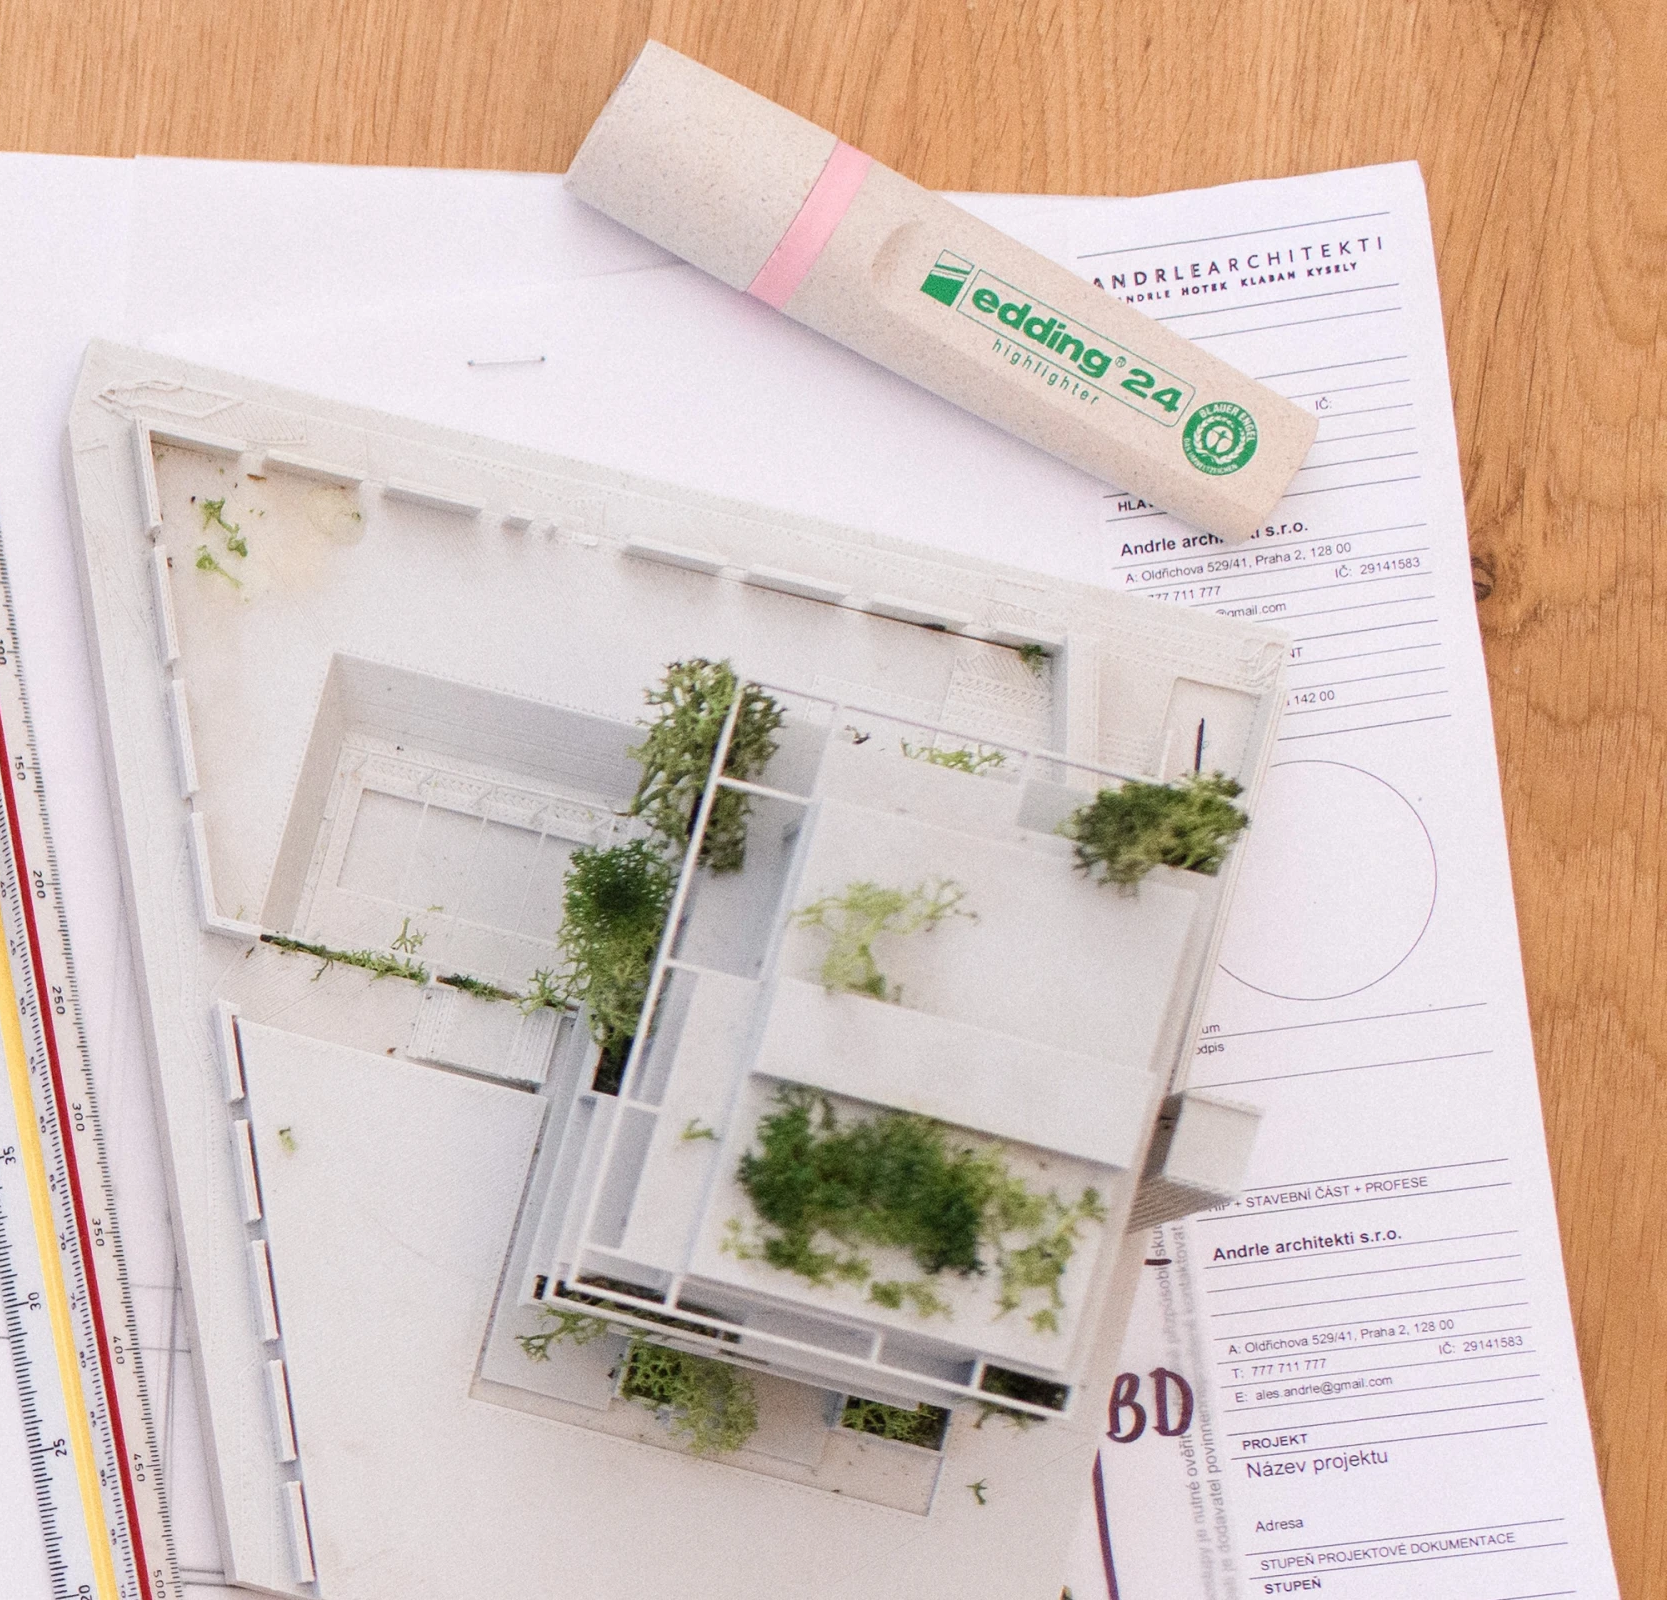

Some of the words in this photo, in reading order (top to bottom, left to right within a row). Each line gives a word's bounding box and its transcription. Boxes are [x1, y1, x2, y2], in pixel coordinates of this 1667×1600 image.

[1118, 290, 1170, 303] NDRLE
[1181, 282, 1228, 297] HOTEK
[992, 339, 1099, 405] highlighter
[1121, 369, 1184, 413] 24
[1199, 404, 1240, 418] BLAUER
[1238, 413, 1255, 442] ENGEL
[1120, 538, 1176, 557] Andrle
[1265, 521, 1308, 537] s.r.o.
[1125, 574, 1138, 584] A:
[1142, 565, 1204, 581] Oldřichova
[1208, 558, 1252, 573] 529/41,
[1255, 553, 1291, 566] Praha
[1311, 547, 1332, 558] 128
[1336, 542, 1352, 553] 00
[1360, 557, 1420, 575] 29141583
[1174, 589, 1194, 601] 711
[1200, 586, 1221, 598] 777
[1295, 693, 1316, 705] 142
[1320, 690, 1335, 701] 00
[15, 755, 26, 781] 150
[33, 870, 45, 898] 200
[52, 986, 65, 1015] 250
[72, 1103, 85, 1132] 300
[3, 1146, 16, 1165] 35
[1246, 1188, 1312, 1208] STAVEBNÍ
[1315, 1185, 1350, 1199] ČÁST
[1365, 1176, 1428, 1193] PROFESE
[92, 1218, 105, 1247] 350
[1213, 1244, 1269, 1261] Andrle
[1275, 1231, 1355, 1254] architekti
[1359, 1228, 1402, 1243] s.r.o.
[28, 1292, 41, 1310] 30
[113, 1336, 125, 1365] 400
[1228, 1345, 1241, 1355] A:
[1245, 1337, 1308, 1354] Oldřichova
[1312, 1330, 1358, 1346] 529/41,
[1361, 1327, 1395, 1340] Praha
[1414, 1321, 1435, 1333] 128
[1439, 1319, 1455, 1330] 00
[1463, 1336, 1523, 1353] 29141583
[1232, 1368, 1244, 1379] T:
[1251, 1364, 1274, 1376] 777
[1278, 1362, 1300, 1374] 711
[1304, 1358, 1327, 1371] 777
[1235, 1392, 1247, 1403] E:
[1255, 1375, 1393, 1401] ales.andrle@gmail.com
[54, 1438, 67, 1457] 25
[1242, 1434, 1307, 1450] PROJEKT
[134, 1453, 145, 1482] 450
[1247, 1457, 1307, 1478] Název
[1313, 1450, 1388, 1476] projektu
[1255, 1518, 1304, 1532] Adresa
[1260, 1552, 1315, 1571] STUPEŇ
[1318, 1543, 1408, 1564] PROJEKTOVÉ
[1411, 1532, 1516, 1554] DOKUMENTACE
[153, 1569, 166, 1599] 500
[1264, 1576, 1322, 1594] STUPEŇ
